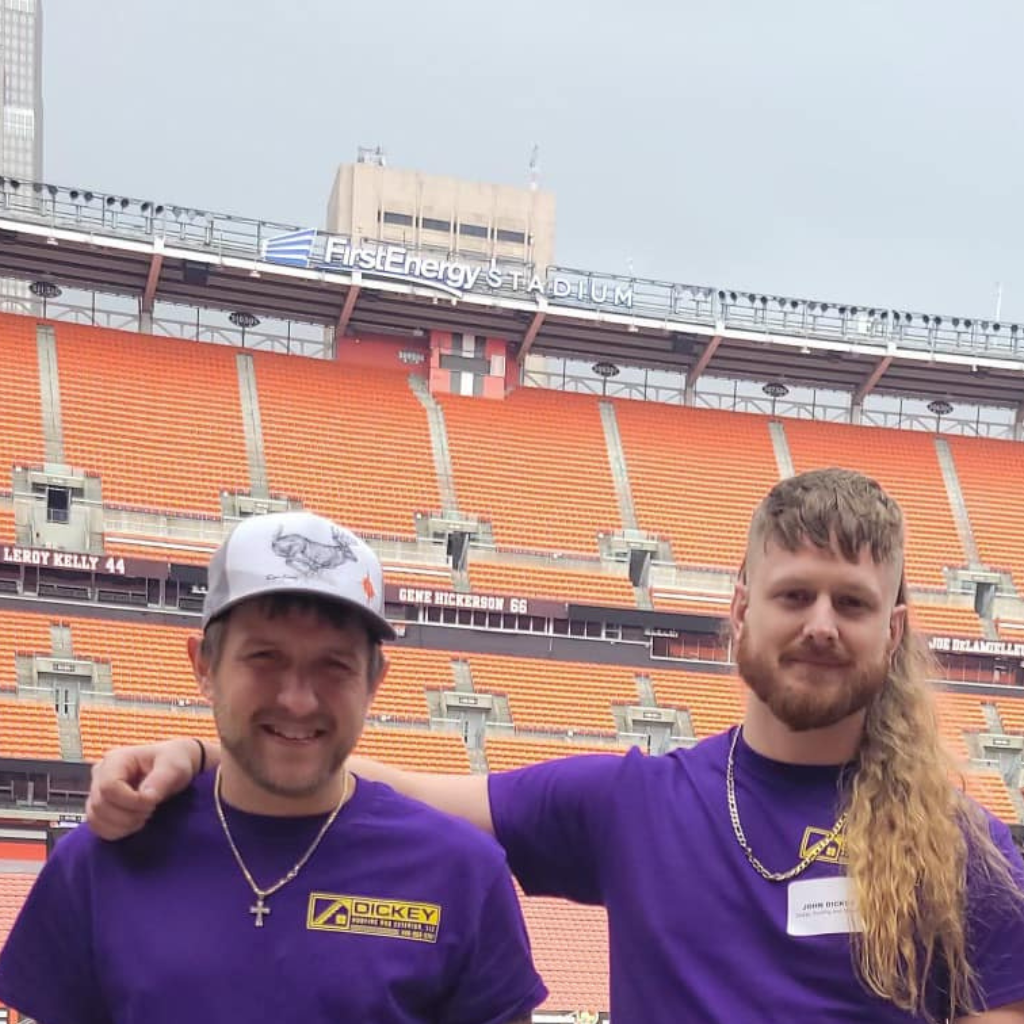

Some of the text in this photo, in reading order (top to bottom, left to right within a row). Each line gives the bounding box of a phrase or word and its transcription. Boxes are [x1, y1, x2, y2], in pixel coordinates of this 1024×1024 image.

[324, 236, 634, 308] FirstEnergy STADIUM
[3, 548, 125, 575] LEROY KELLY 44
[399, 588, 528, 613] GENE HICKERSON 66
[928, 636, 950, 651] JOE
[354, 902, 436, 921] DICKEY
[802, 901, 824, 910] JOHN
